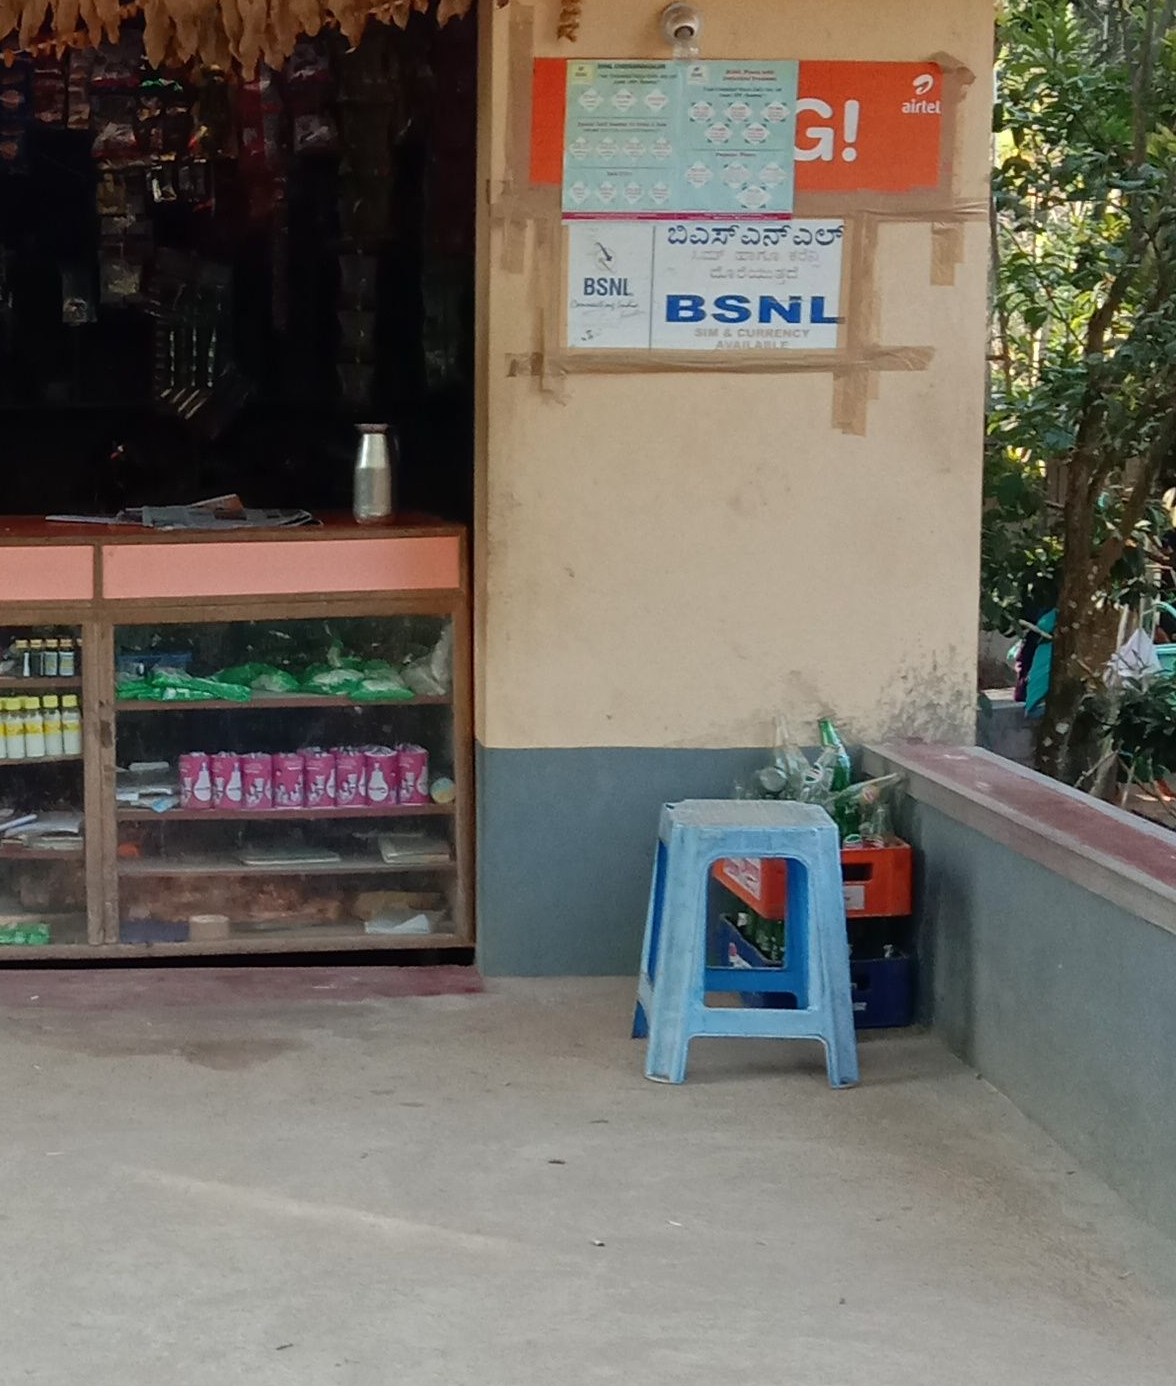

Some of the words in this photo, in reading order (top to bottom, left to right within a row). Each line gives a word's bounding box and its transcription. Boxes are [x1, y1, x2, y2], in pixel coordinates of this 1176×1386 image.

[901, 98, 942, 114] airtel
[583, 277, 634, 296] BSNL
[666, 294, 845, 324] BSNL
[694, 328, 719, 338] SIM
[737, 328, 810, 338] CURRENCY
[716, 340, 789, 350] AVAILABLE
